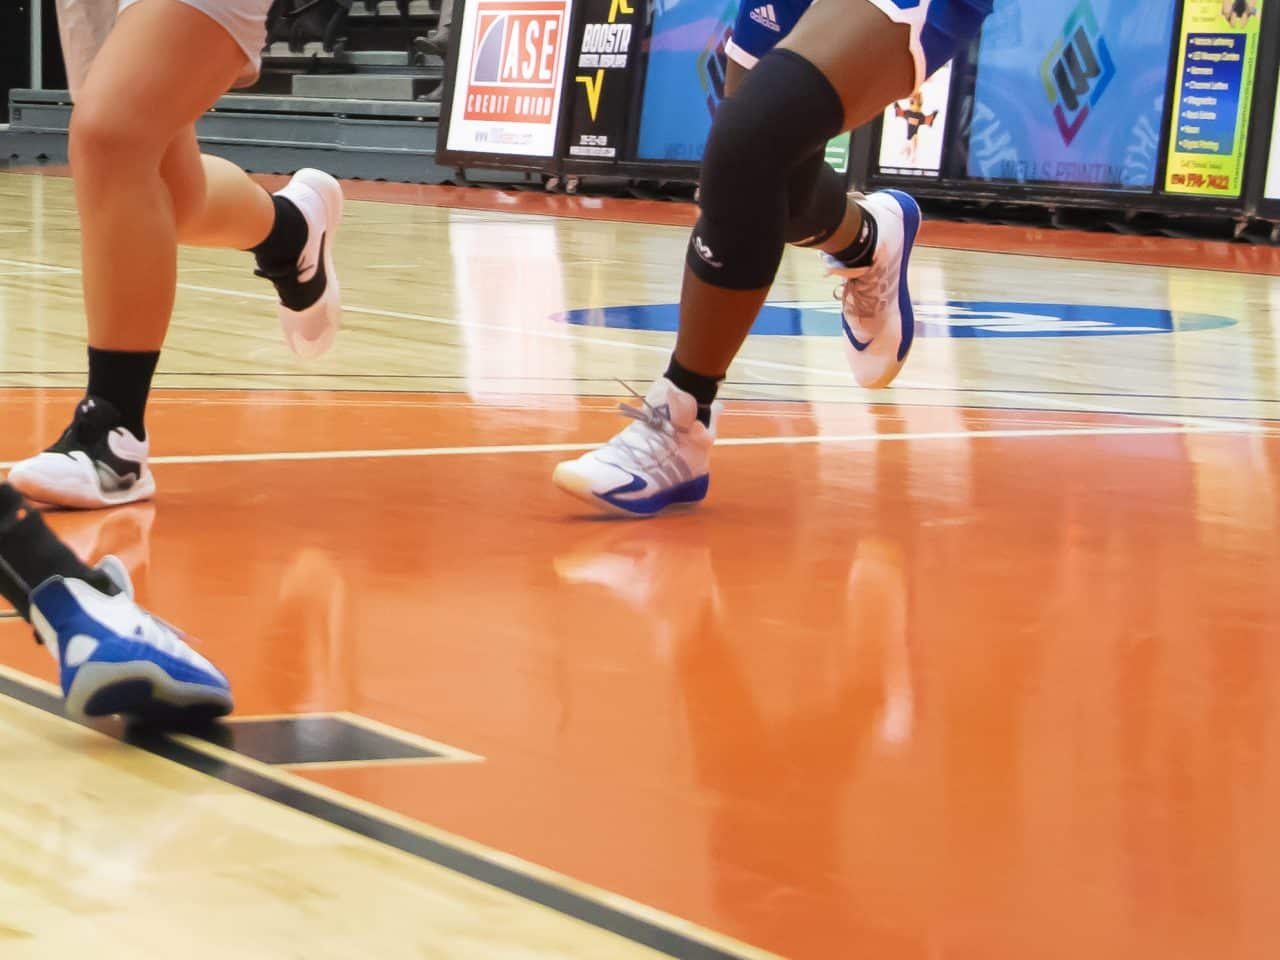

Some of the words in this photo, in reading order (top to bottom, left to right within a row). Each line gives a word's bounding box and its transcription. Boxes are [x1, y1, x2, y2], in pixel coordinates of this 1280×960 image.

[503, 18, 558, 81] ASE
[581, 23, 633, 53] BOOSTR
[466, 94, 510, 114] CREDIT
